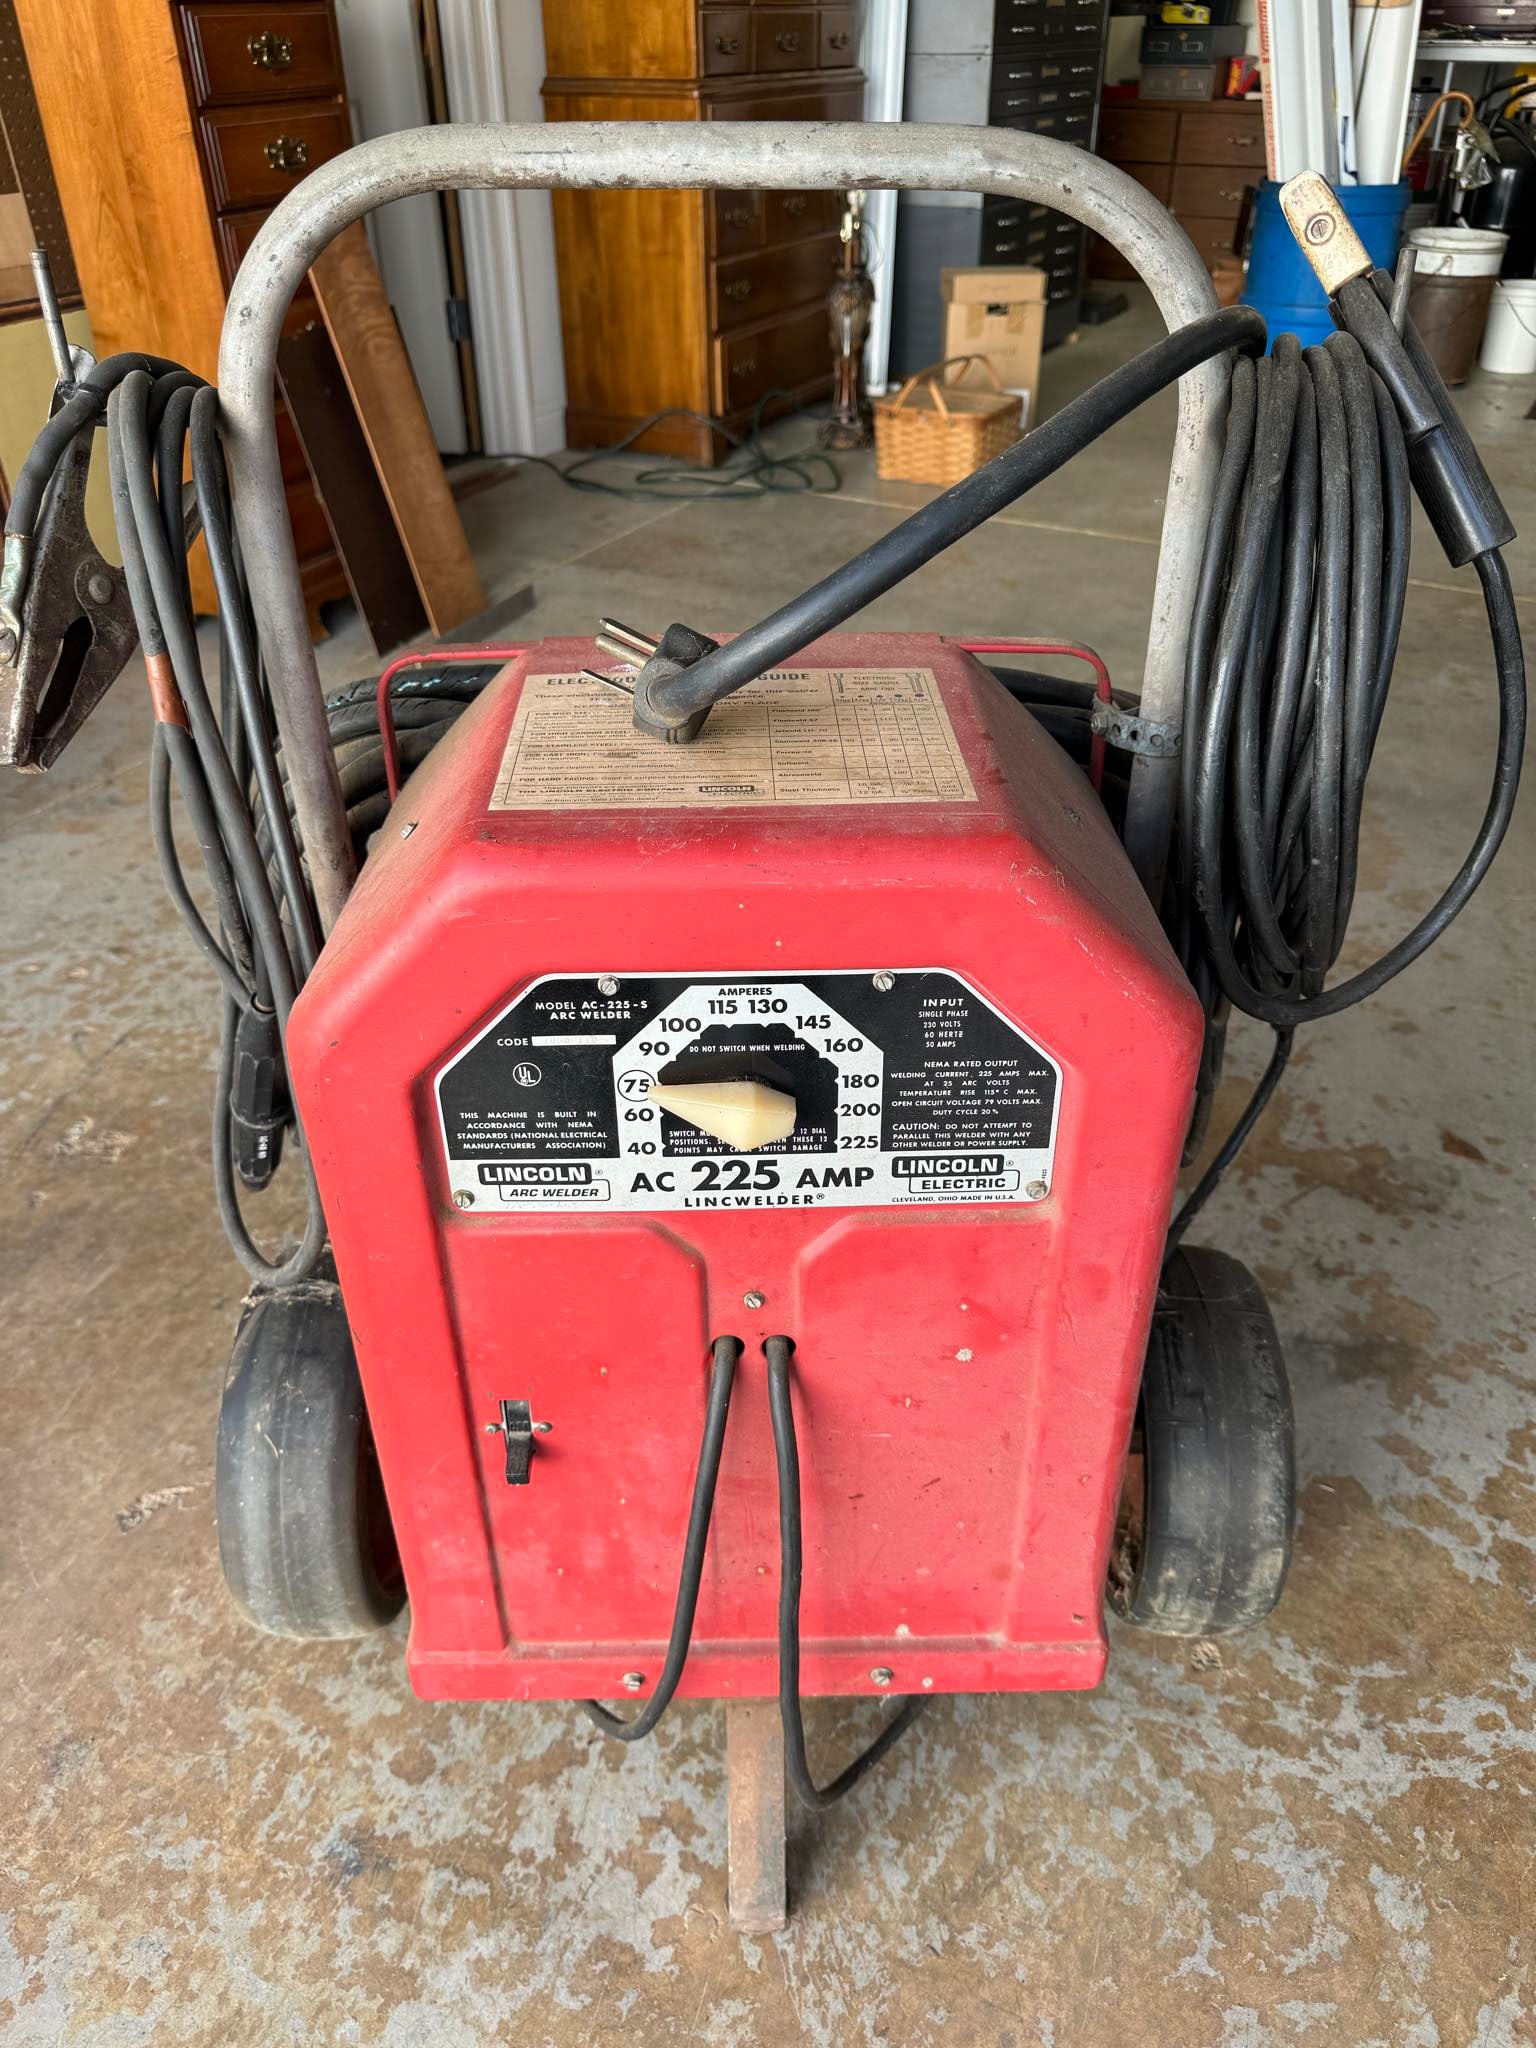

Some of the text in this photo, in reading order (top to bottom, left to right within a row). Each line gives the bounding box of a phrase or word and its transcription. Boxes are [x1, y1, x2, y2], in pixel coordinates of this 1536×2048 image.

[757, 673, 811, 681] GUIDE
[718, 987, 773, 996] AMPERES
[535, 1002, 576, 1010] MODEL
[707, 998, 788, 1015] 115 130
[923, 998, 964, 1007] INPUT
[550, 1010, 631, 1020] ARC WELDER
[795, 1014, 832, 1030] 145
[658, 1017, 702, 1033] 100
[496, 1038, 529, 1046] CODE
[638, 1041, 671, 1056] 90
[824, 1038, 864, 1053] 160
[623, 1079, 649, 1093] 75
[842, 1074, 880, 1088] 180
[624, 1108, 654, 1122] 60
[840, 1103, 881, 1117] 200
[892, 1122, 940, 1131] CAUTION:
[627, 1142, 657, 1156] 40
[840, 1136, 879, 1150] 225
[897, 1158, 998, 1174] LINCOLN
[483, 1166, 586, 1182] LINCOLN
[630, 1159, 875, 1193] AC 225 AMP
[922, 1178, 1006, 1190] ELECTRIC
[509, 1188, 600, 1197] ARC WELDER
